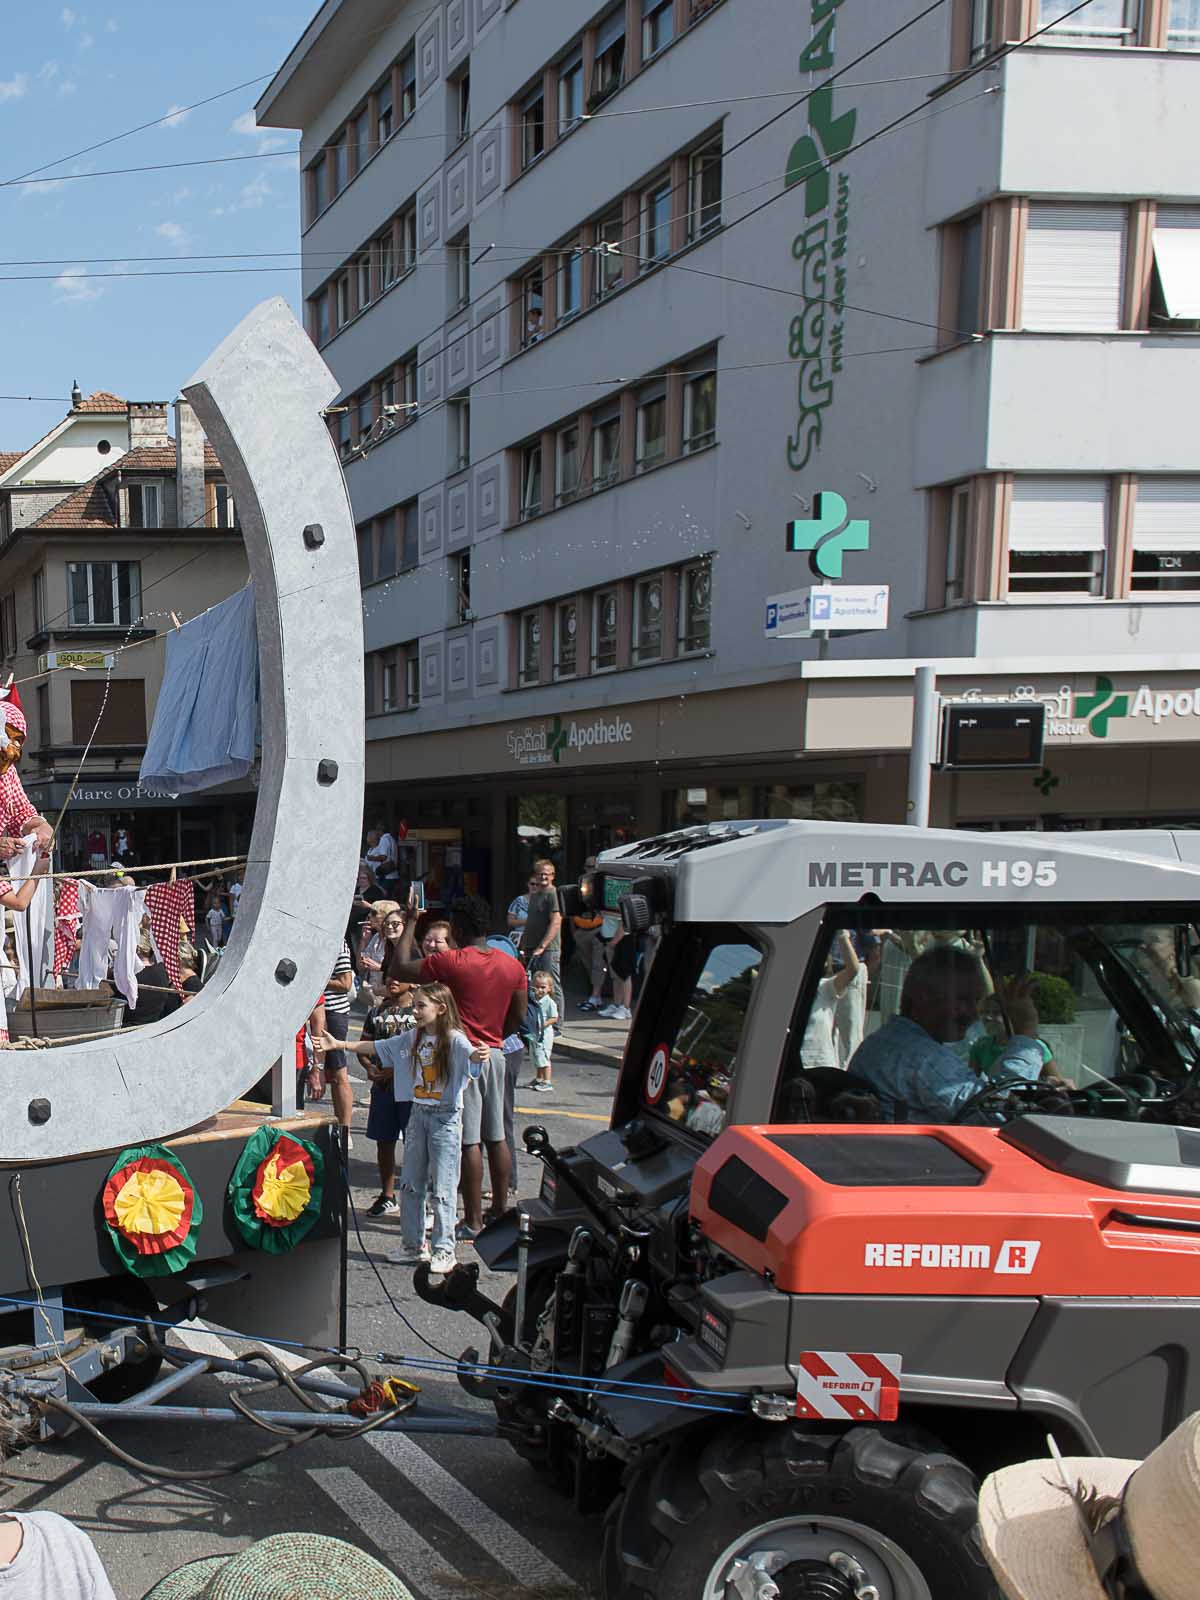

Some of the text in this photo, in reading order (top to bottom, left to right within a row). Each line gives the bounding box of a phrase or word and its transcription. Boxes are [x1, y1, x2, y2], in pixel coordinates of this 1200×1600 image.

[828, 172, 849, 373] mit der Natur
[787, 218, 833, 472] Späni
[568, 715, 633, 752] Apotheke
[1048, 722, 1087, 736] Natur
[70, 788, 113, 800] Marc
[808, 860, 1058, 888] METRAC H95
[650, 1060, 663, 1089] 40
[864, 1243, 991, 1268] REFORM
[822, 1381, 860, 1390] REFORM
